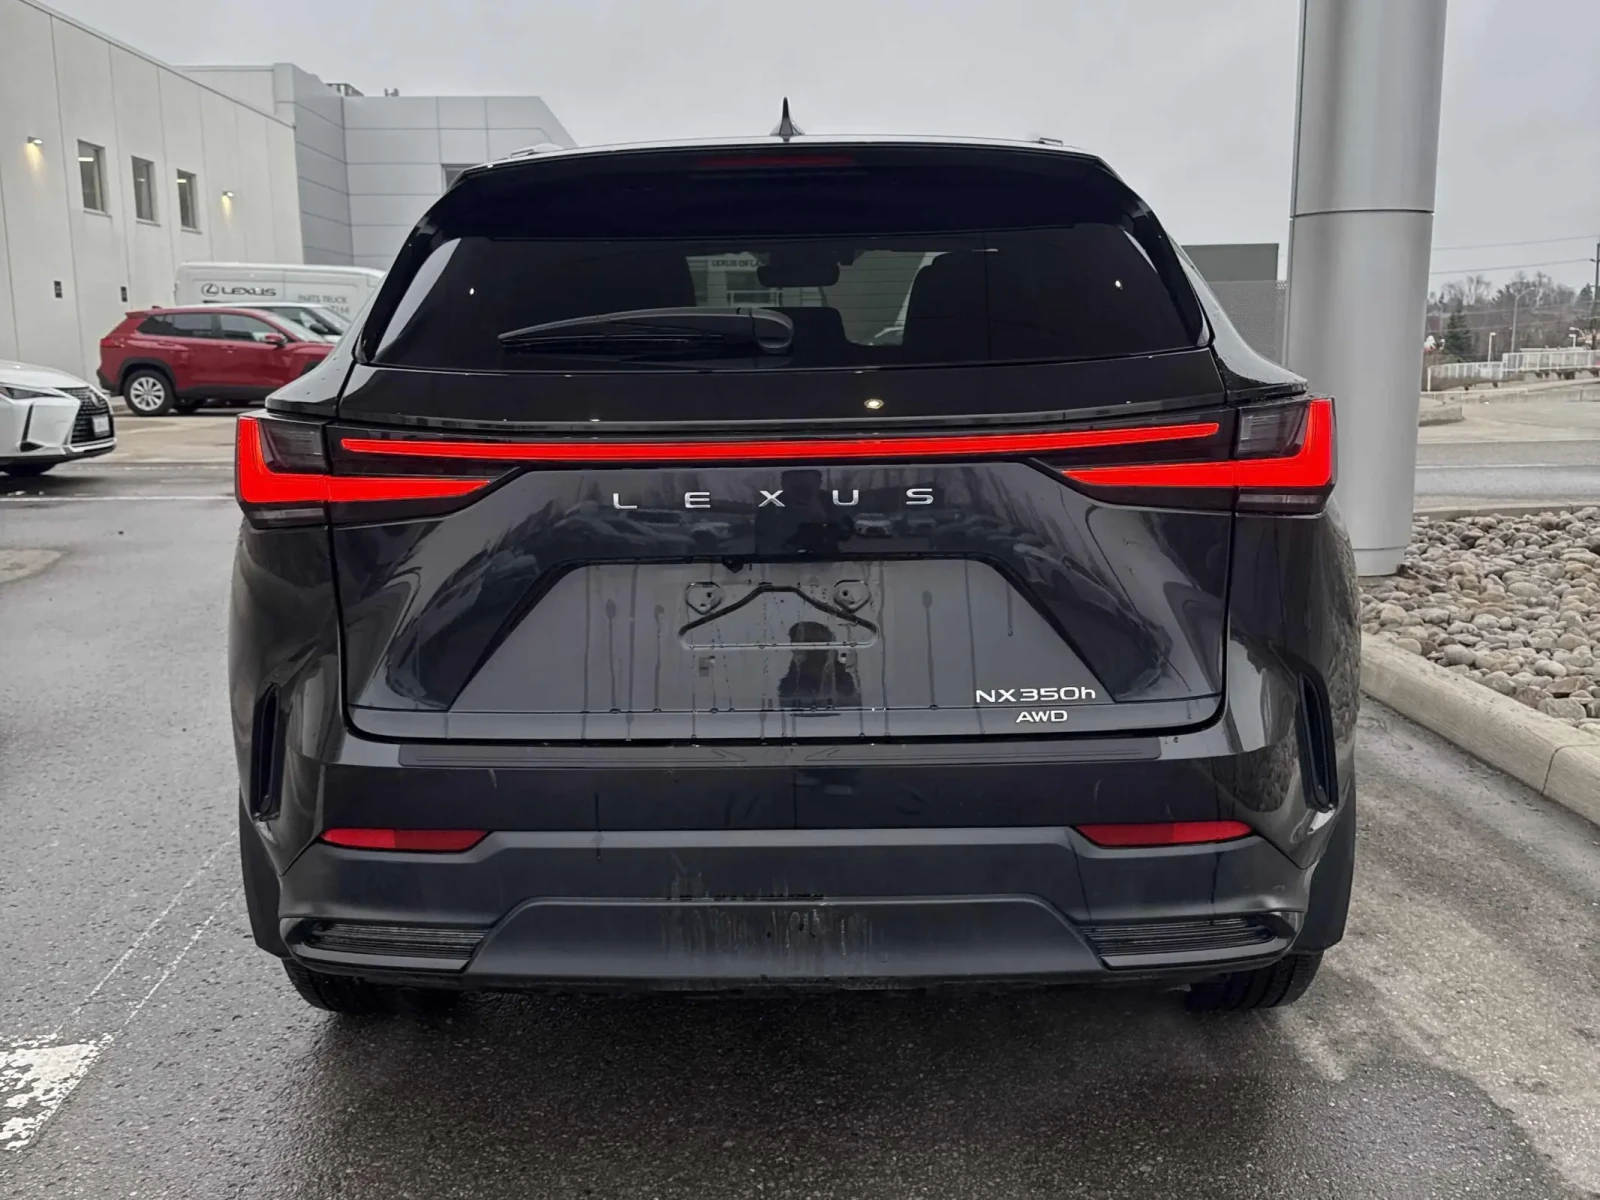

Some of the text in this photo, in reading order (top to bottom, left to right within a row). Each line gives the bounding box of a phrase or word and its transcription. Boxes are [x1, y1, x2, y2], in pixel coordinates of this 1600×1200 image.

[221, 286, 277, 297] LEXUS
[297, 294, 348, 305] PARTS TRUCK
[612, 488, 934, 509] LEXUS
[1015, 710, 1068, 724] AWD
